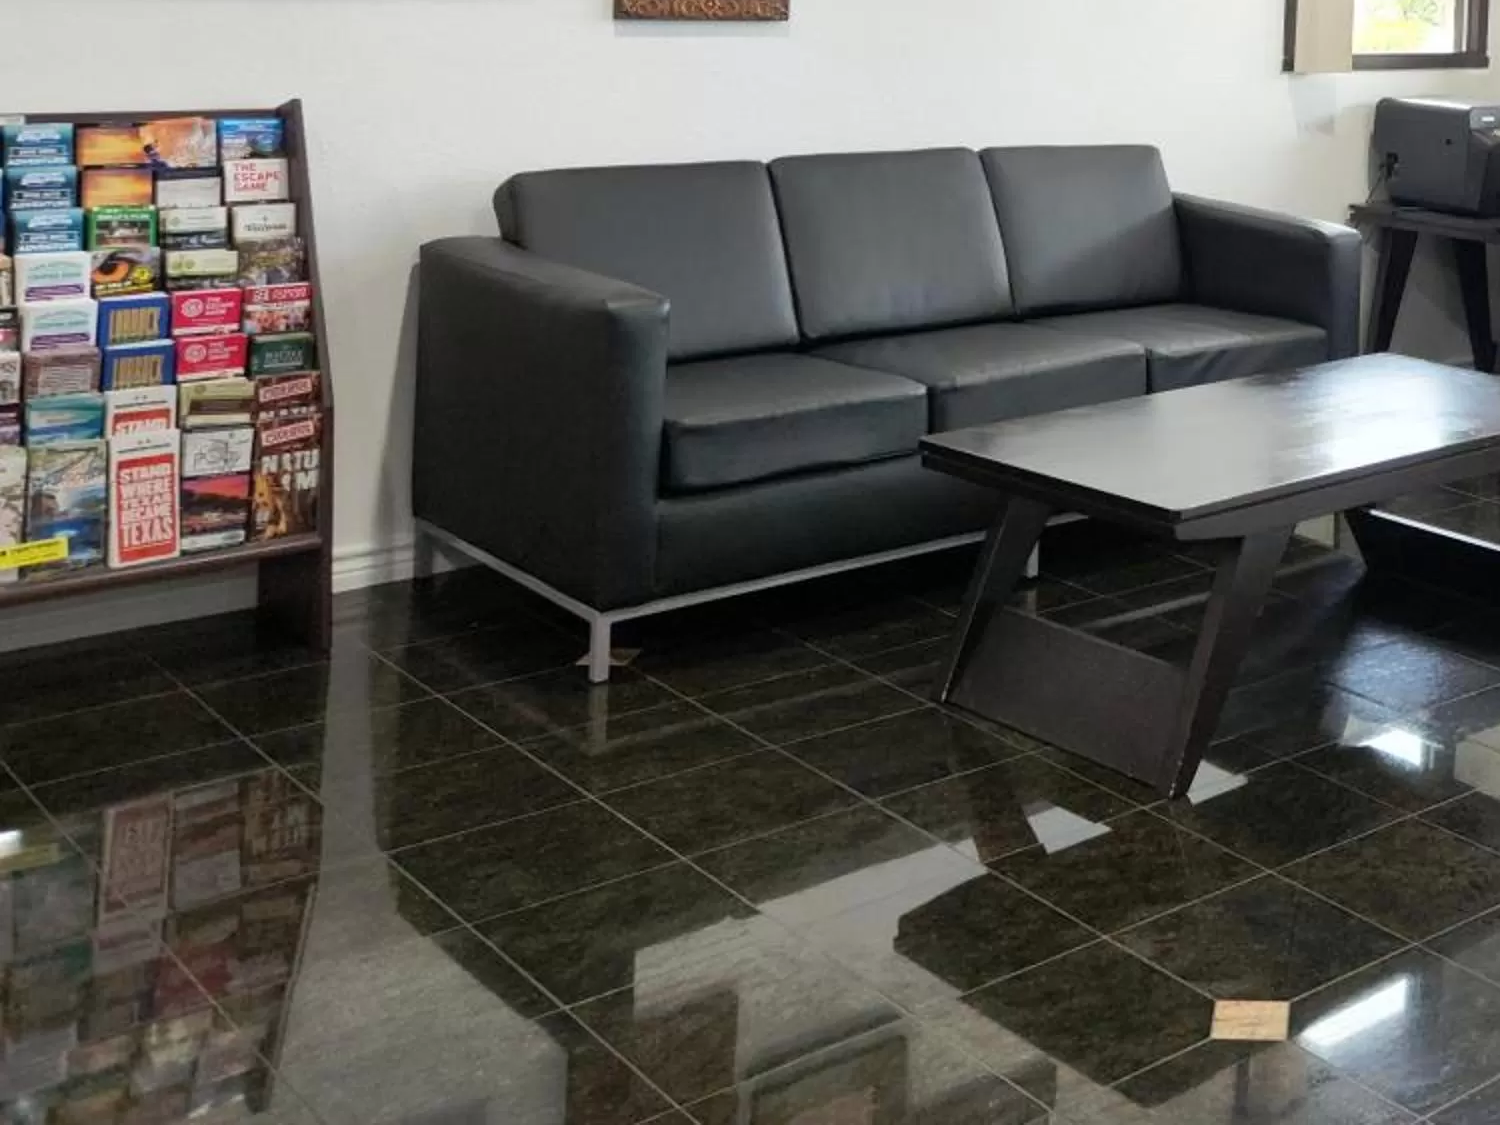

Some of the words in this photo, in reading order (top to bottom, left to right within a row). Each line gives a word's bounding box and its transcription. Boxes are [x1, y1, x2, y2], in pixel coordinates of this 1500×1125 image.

[234, 162, 257, 172] THE
[234, 170, 282, 182] ESCAPE
[122, 516, 173, 548] TEXAS
